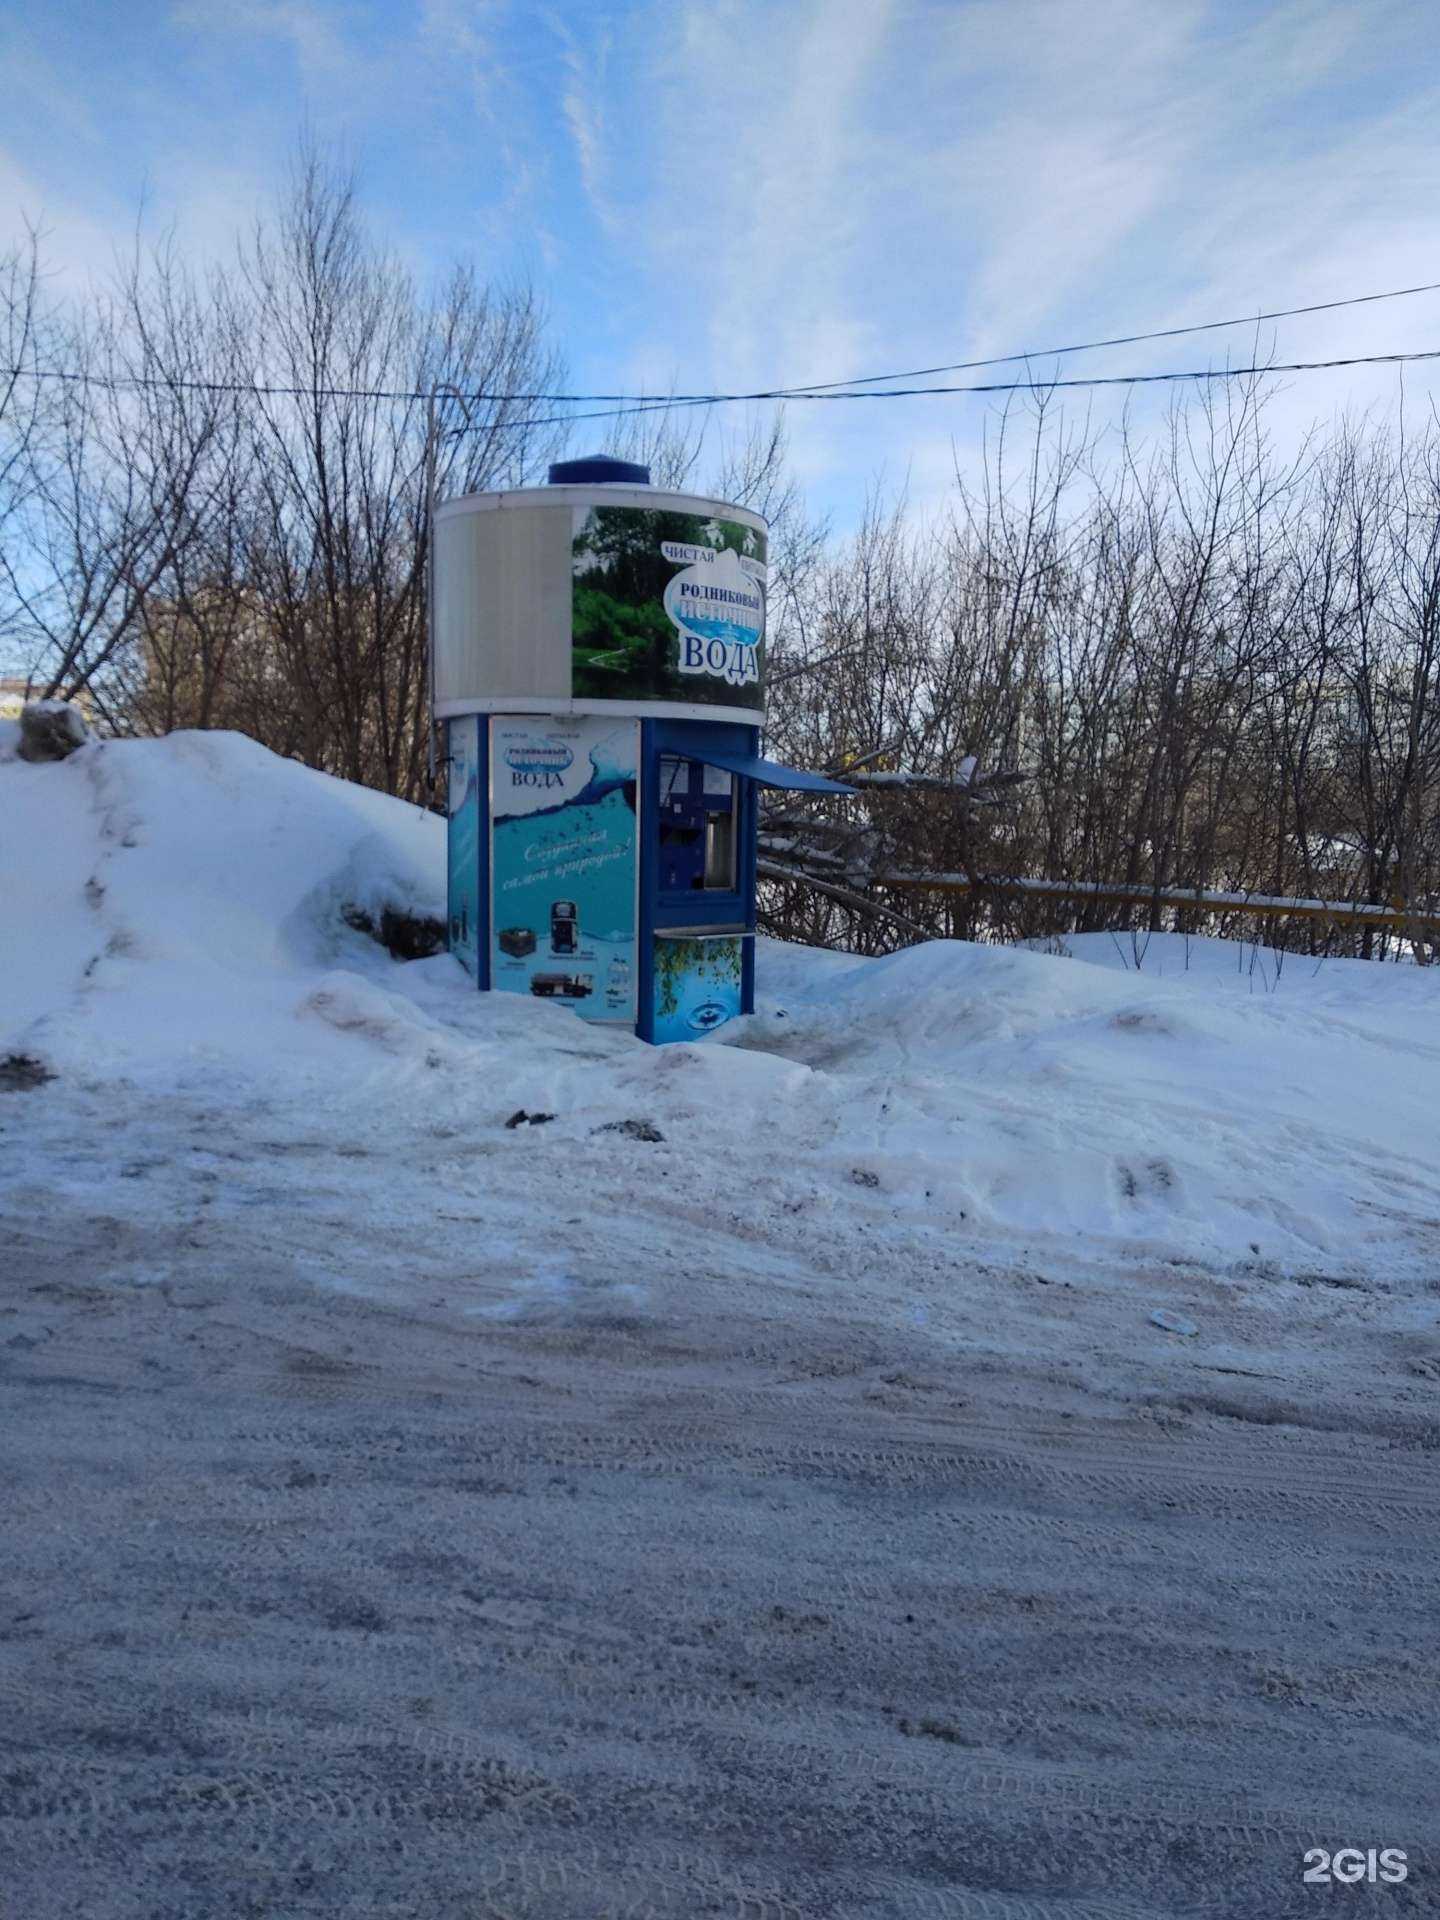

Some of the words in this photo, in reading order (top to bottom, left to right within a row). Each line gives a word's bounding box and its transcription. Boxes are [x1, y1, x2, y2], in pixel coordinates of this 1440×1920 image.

[664, 545, 715, 563] ЧИСТАЯ
[685, 636, 757, 679] ВОДА
[512, 771, 564, 789] ВОДА
